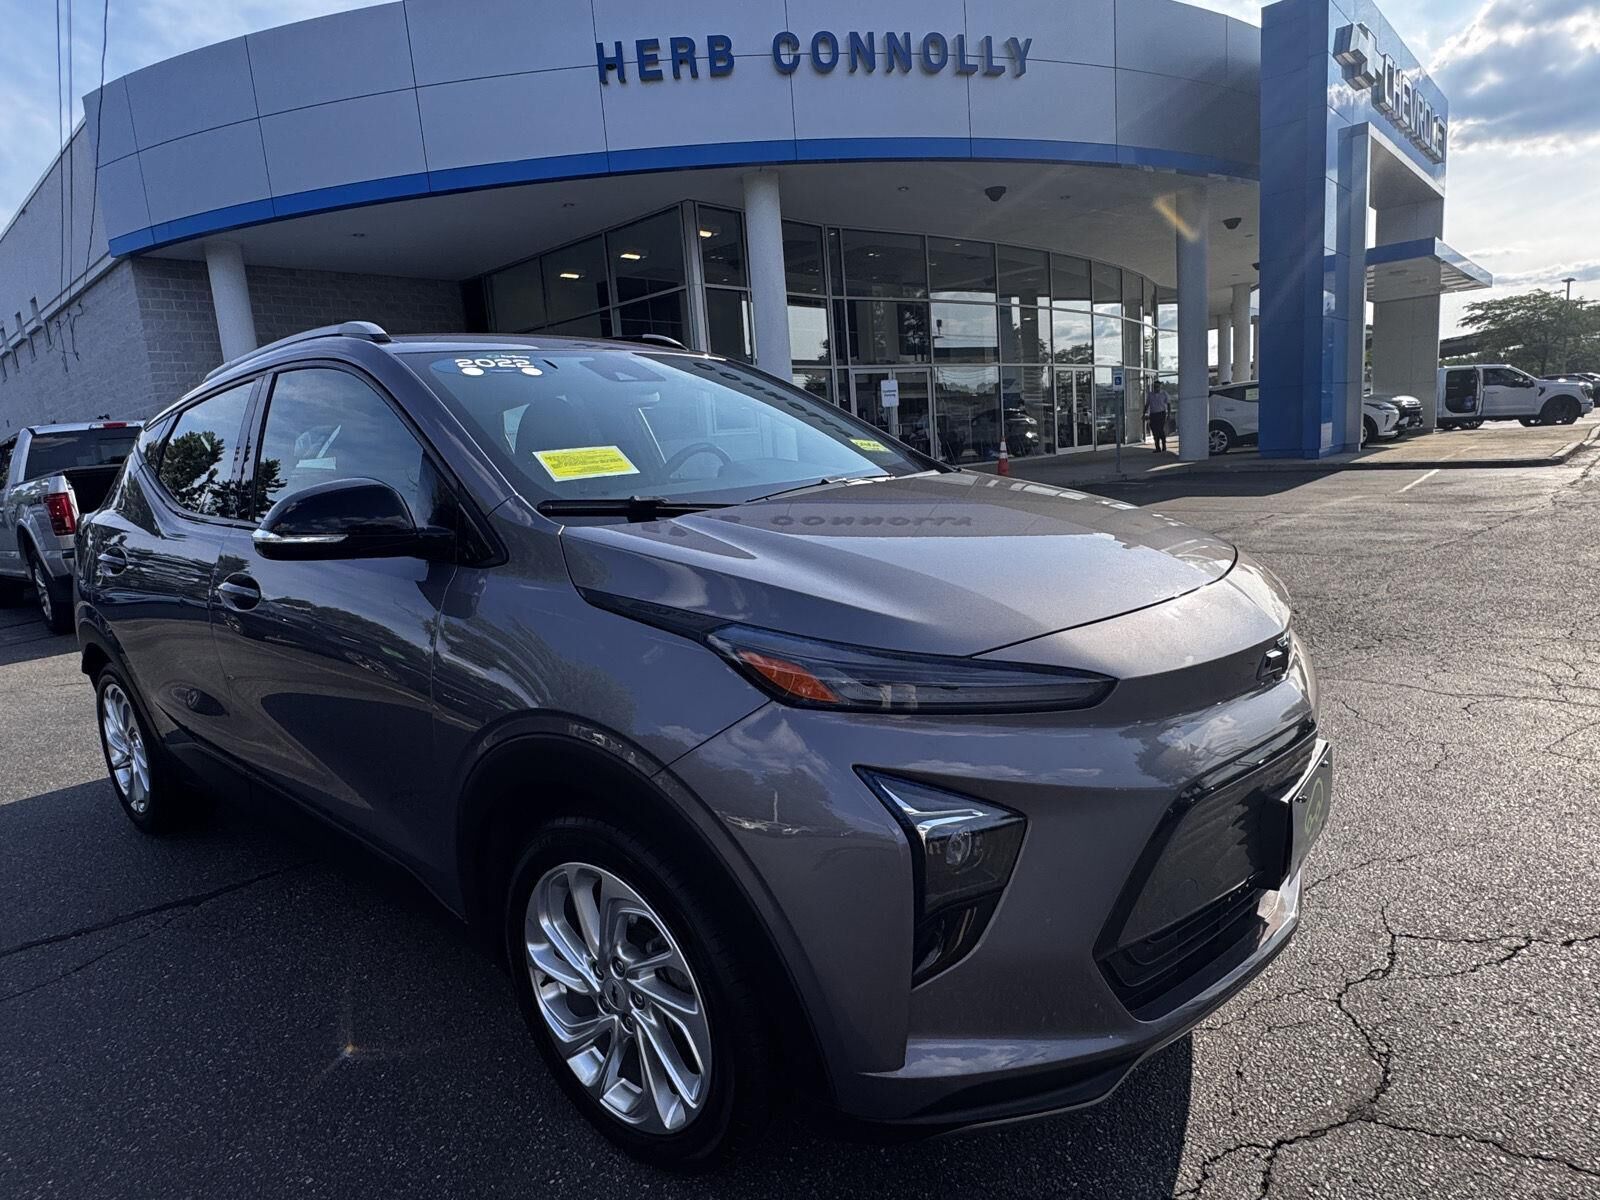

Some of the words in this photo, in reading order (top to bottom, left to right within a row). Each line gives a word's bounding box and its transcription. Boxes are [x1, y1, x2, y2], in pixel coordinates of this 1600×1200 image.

[596, 34, 735, 85] HERB
[771, 30, 1033, 79] CONNOLLY
[454, 358, 535, 368] 2022
